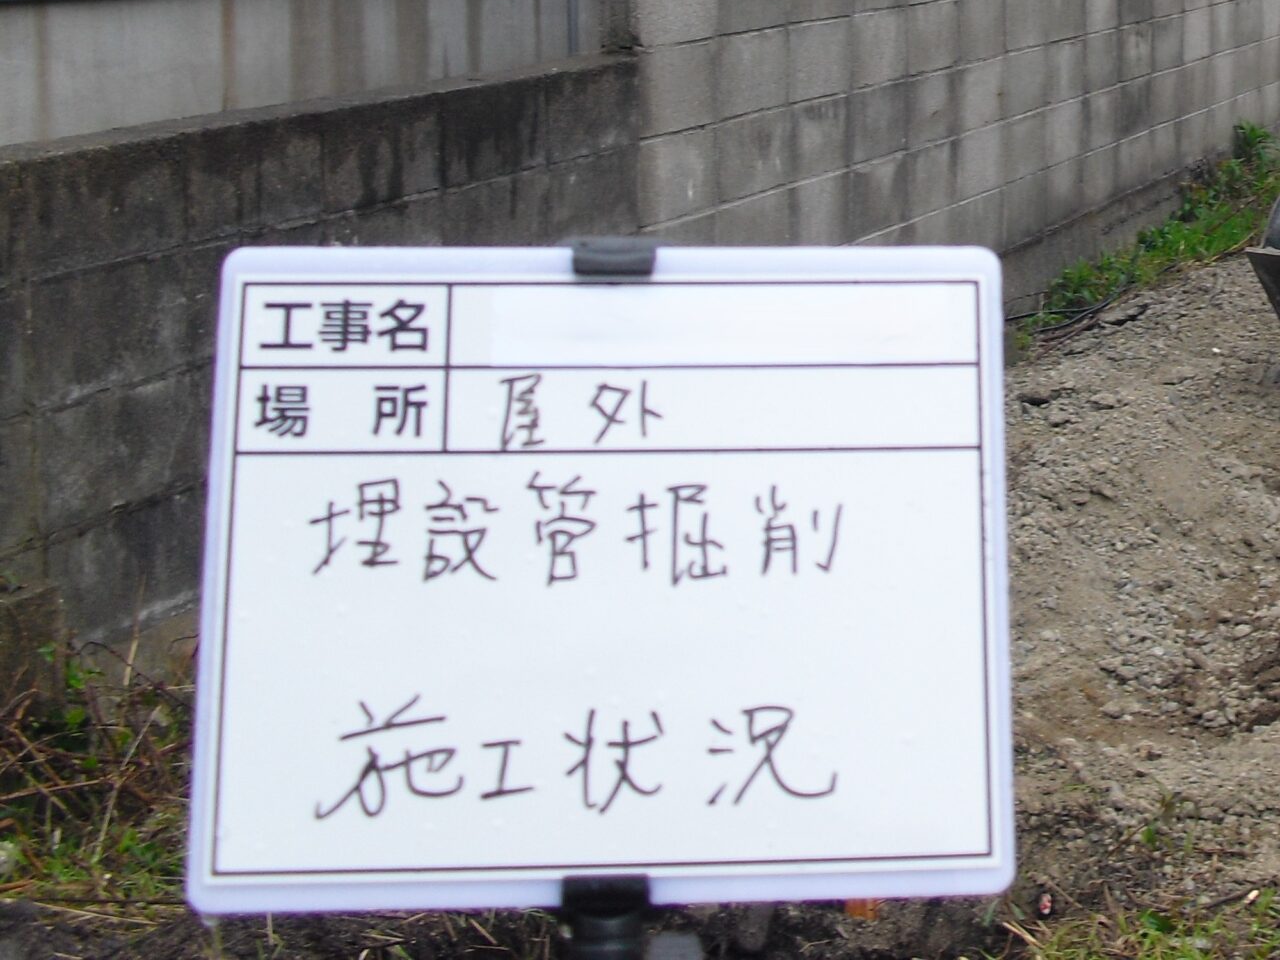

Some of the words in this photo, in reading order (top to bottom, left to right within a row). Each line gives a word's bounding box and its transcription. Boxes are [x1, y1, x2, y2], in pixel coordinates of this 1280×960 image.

[259, 299, 430, 353] 工事名
[499, 373, 664, 449] 屋外
[308, 470, 843, 587] 埋設管掘削
[314, 695, 838, 821] 施工状況
